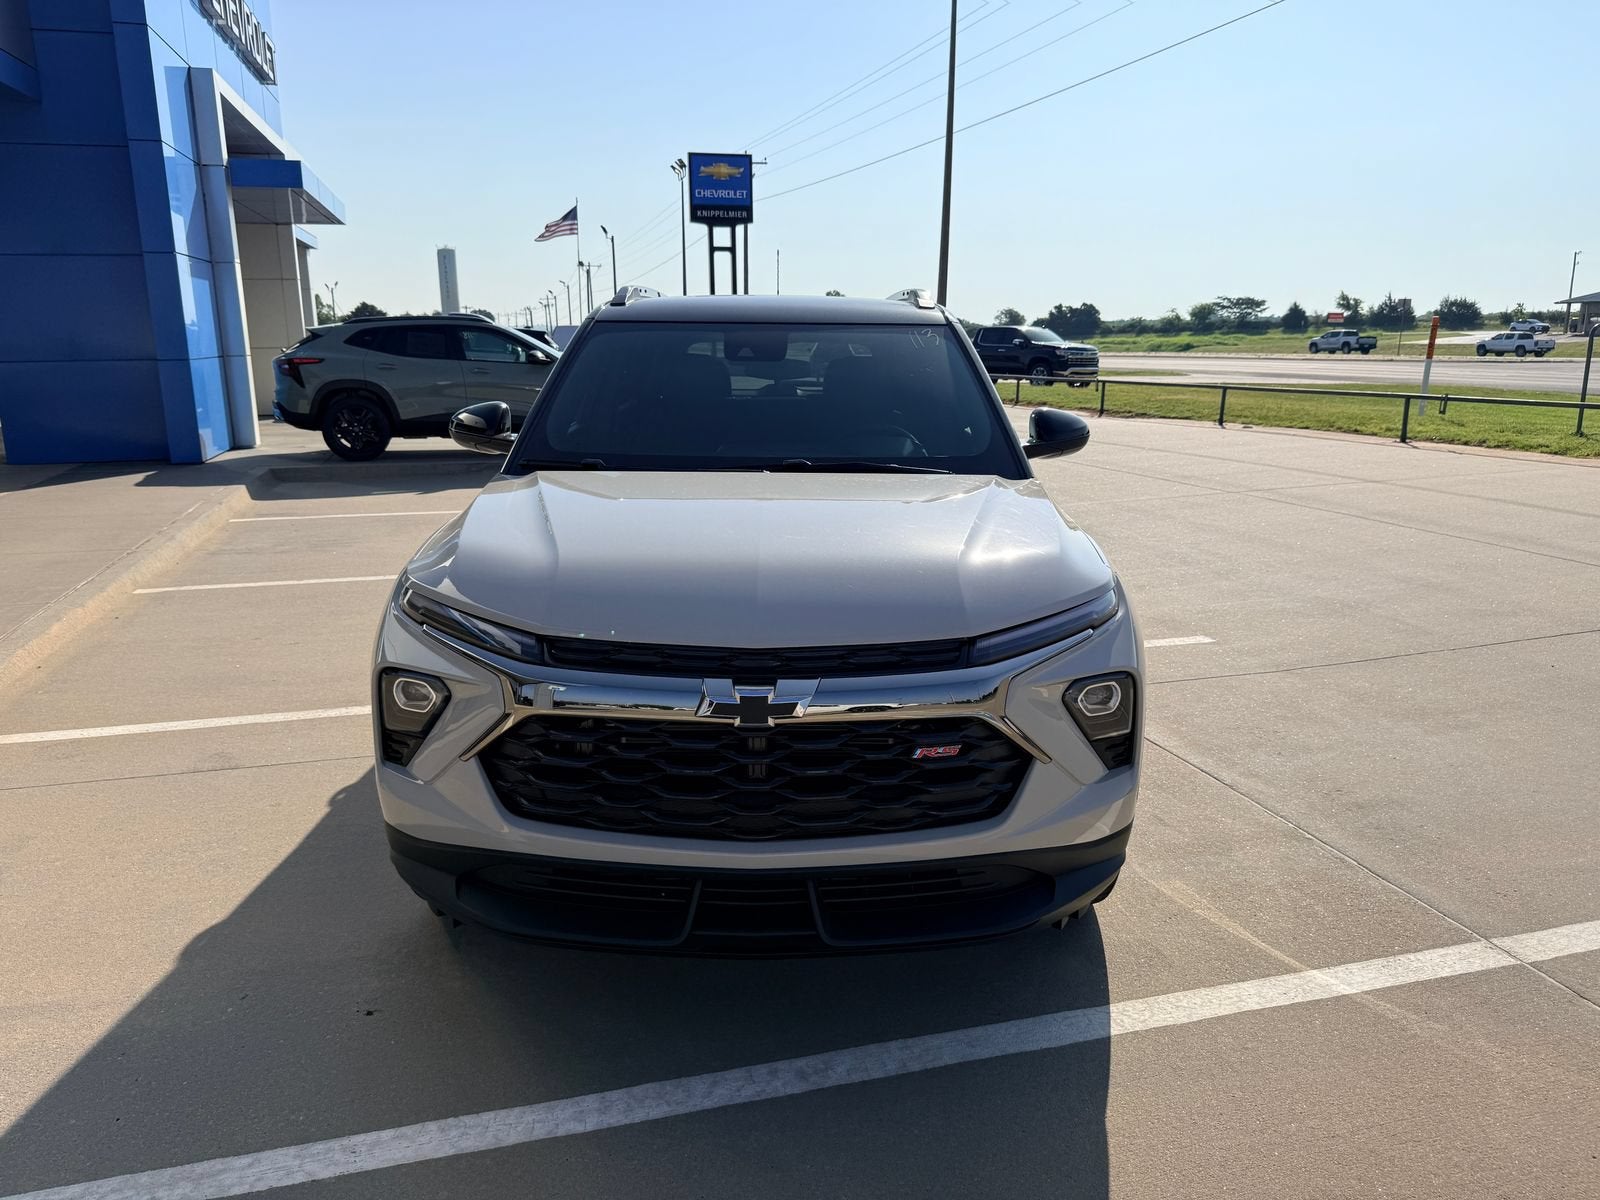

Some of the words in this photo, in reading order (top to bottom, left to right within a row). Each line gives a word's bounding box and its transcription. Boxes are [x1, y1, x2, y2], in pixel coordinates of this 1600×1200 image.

[211, 0, 277, 83] EVROLET
[695, 189, 748, 199] CHEVROLET
[696, 209, 748, 219] KNIPPELMIER
[908, 328, 940, 350] 113
[912, 745, 962, 759] RS
